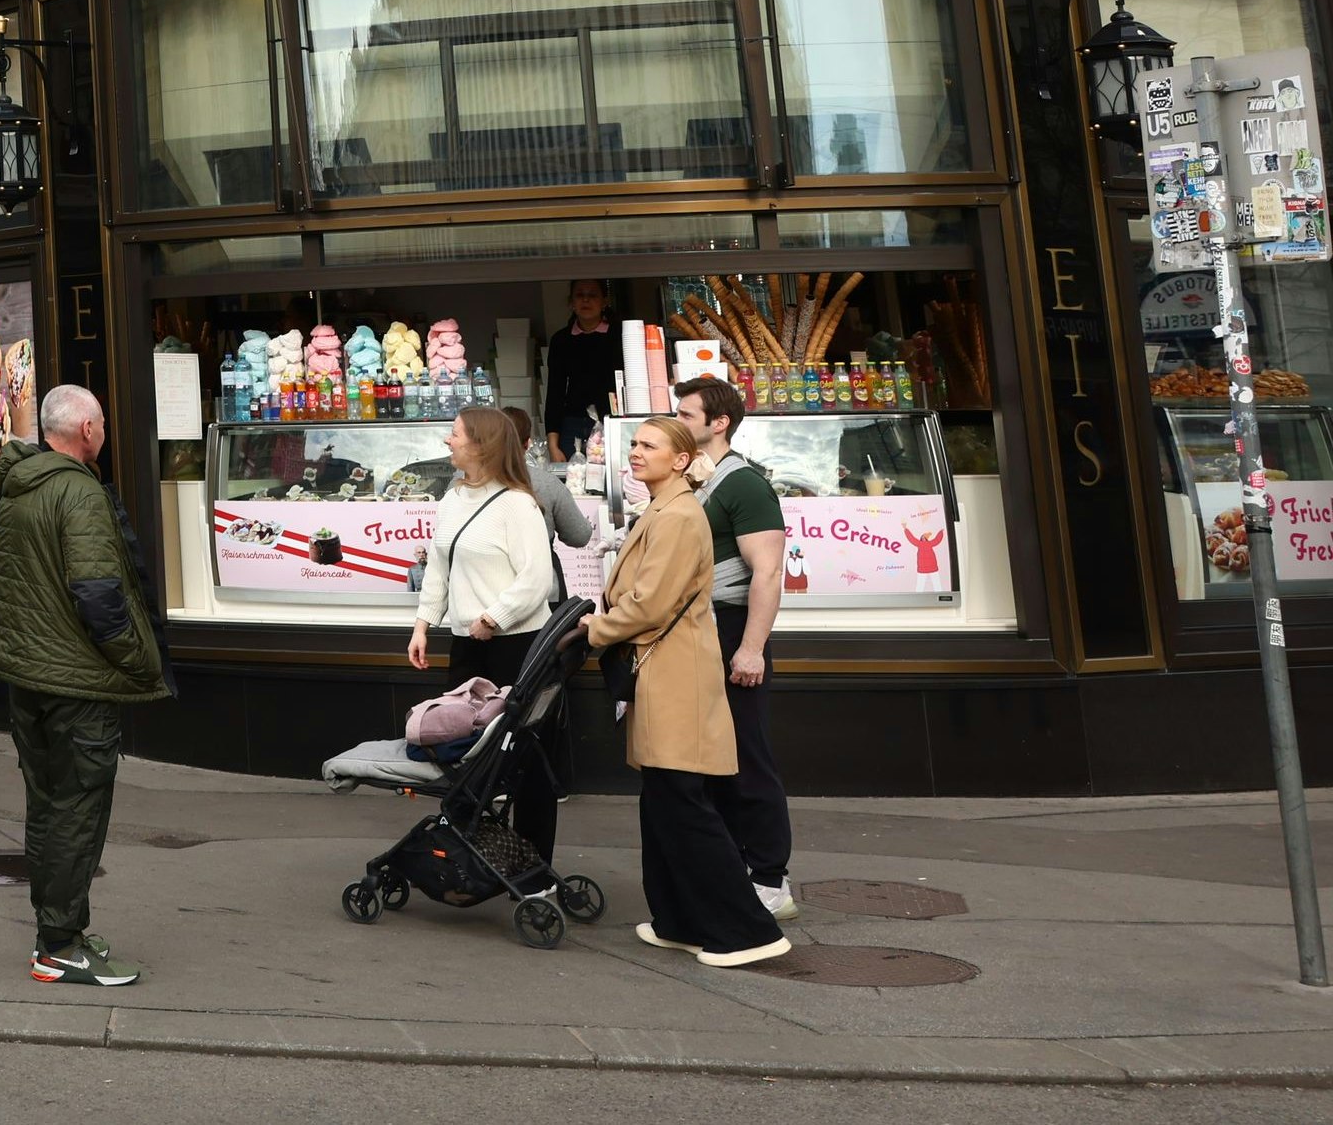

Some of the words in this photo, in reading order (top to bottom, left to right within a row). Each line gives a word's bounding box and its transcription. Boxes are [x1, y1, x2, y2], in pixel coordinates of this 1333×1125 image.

[1147, 112, 1172, 136] U5
[1281, 497, 1333, 526] Frisc
[364, 518, 434, 545] Tradi
[784, 525, 793, 538] e
[801, 517, 824, 539] la
[830, 518, 902, 554] Crème
[221, 548, 284, 561] Kaiserschmarrn
[1290, 531, 1333, 562] Fres
[300, 567, 353, 579] Kaisercake
